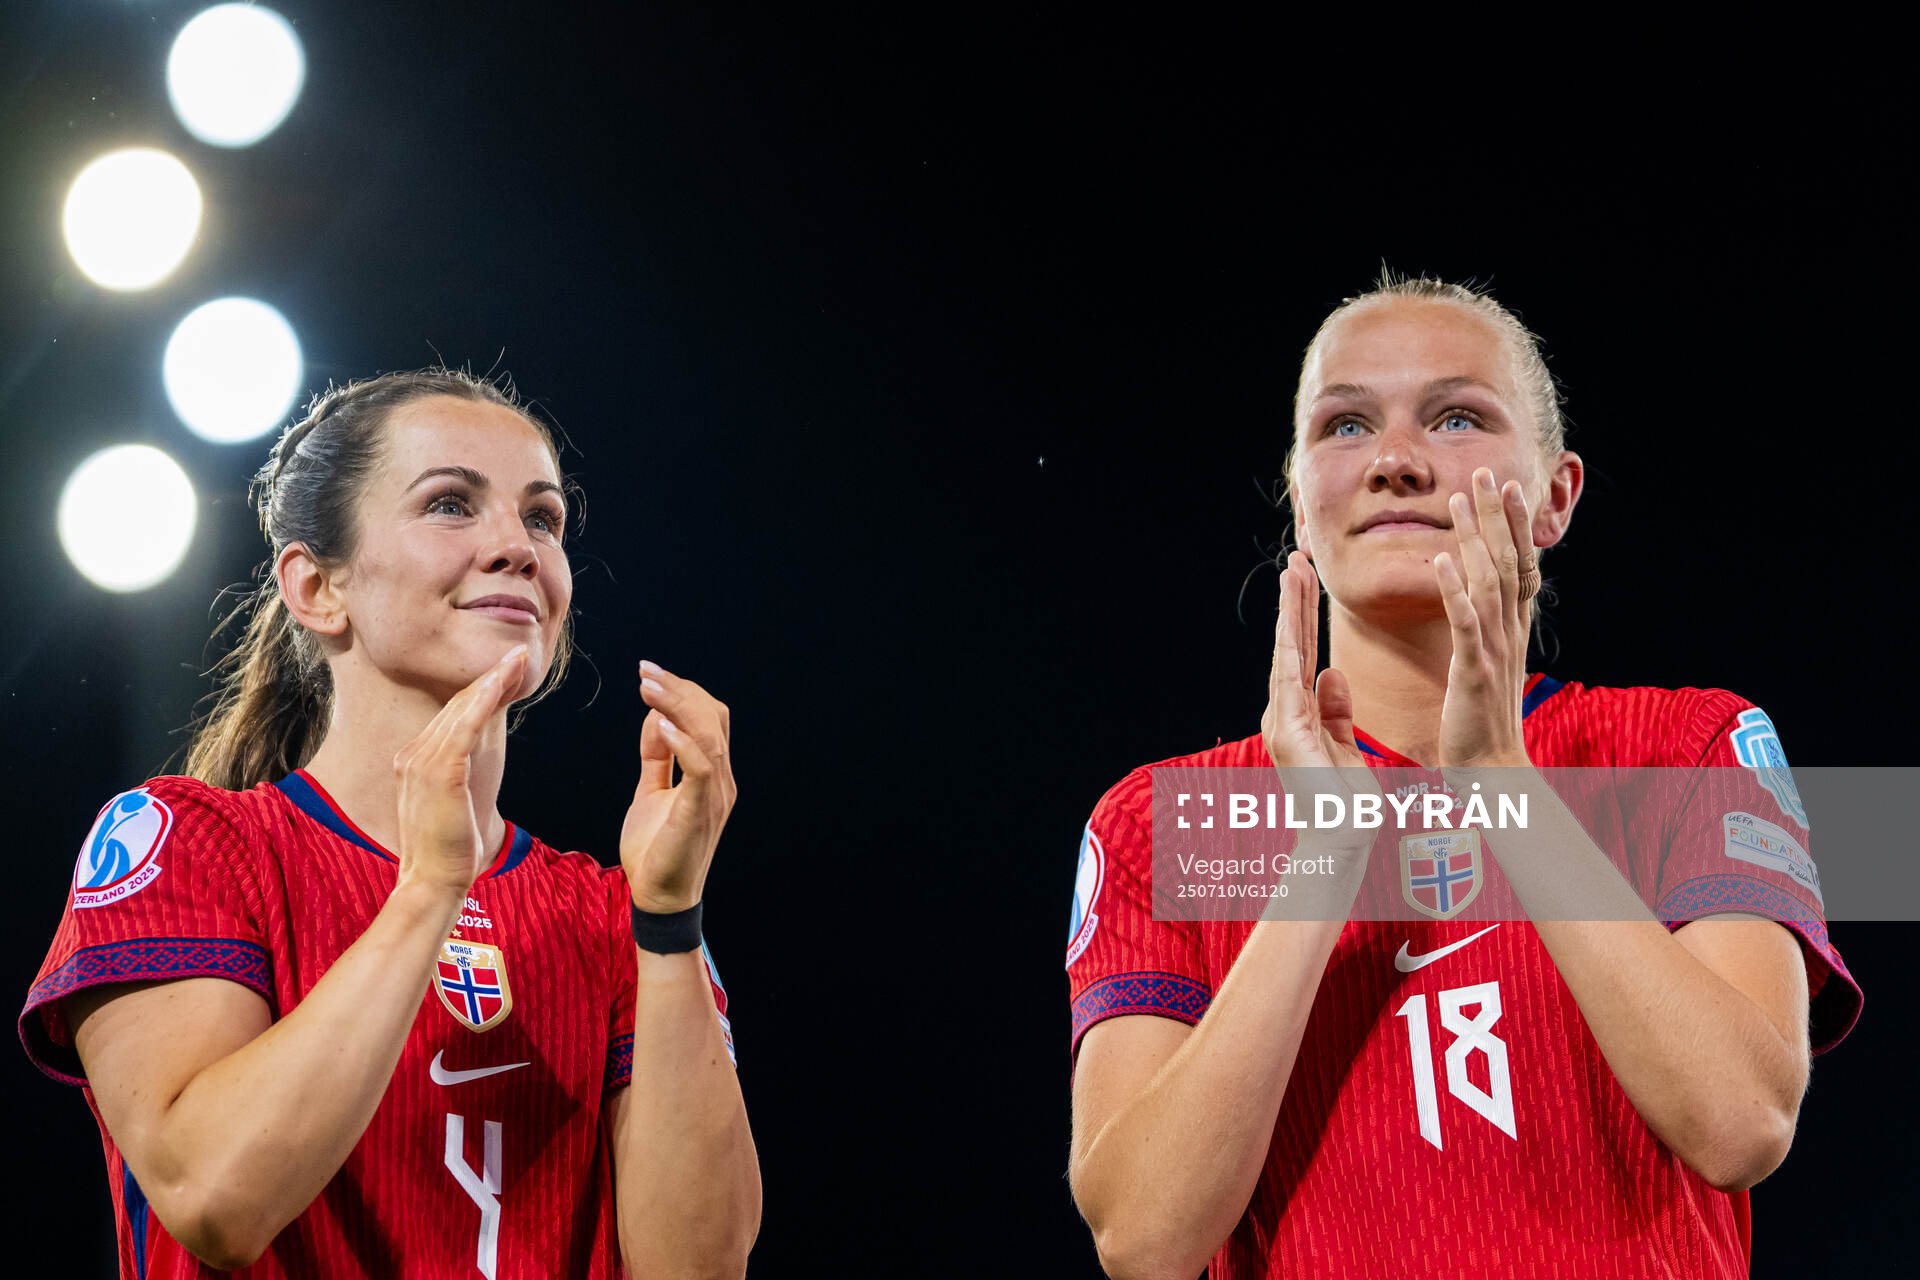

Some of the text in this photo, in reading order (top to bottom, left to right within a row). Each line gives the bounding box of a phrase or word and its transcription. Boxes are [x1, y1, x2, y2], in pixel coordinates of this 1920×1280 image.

[1396, 782, 1429, 798] NOR
[1728, 815, 1754, 826] UEFA
[1428, 836, 1452, 847] NORGE
[128, 866, 155, 890] 2025
[1081, 918, 1094, 944] 2025
[449, 944, 473, 956] NORGE
[1395, 981, 1518, 1152] 18
[444, 1112, 503, 1280] 4
